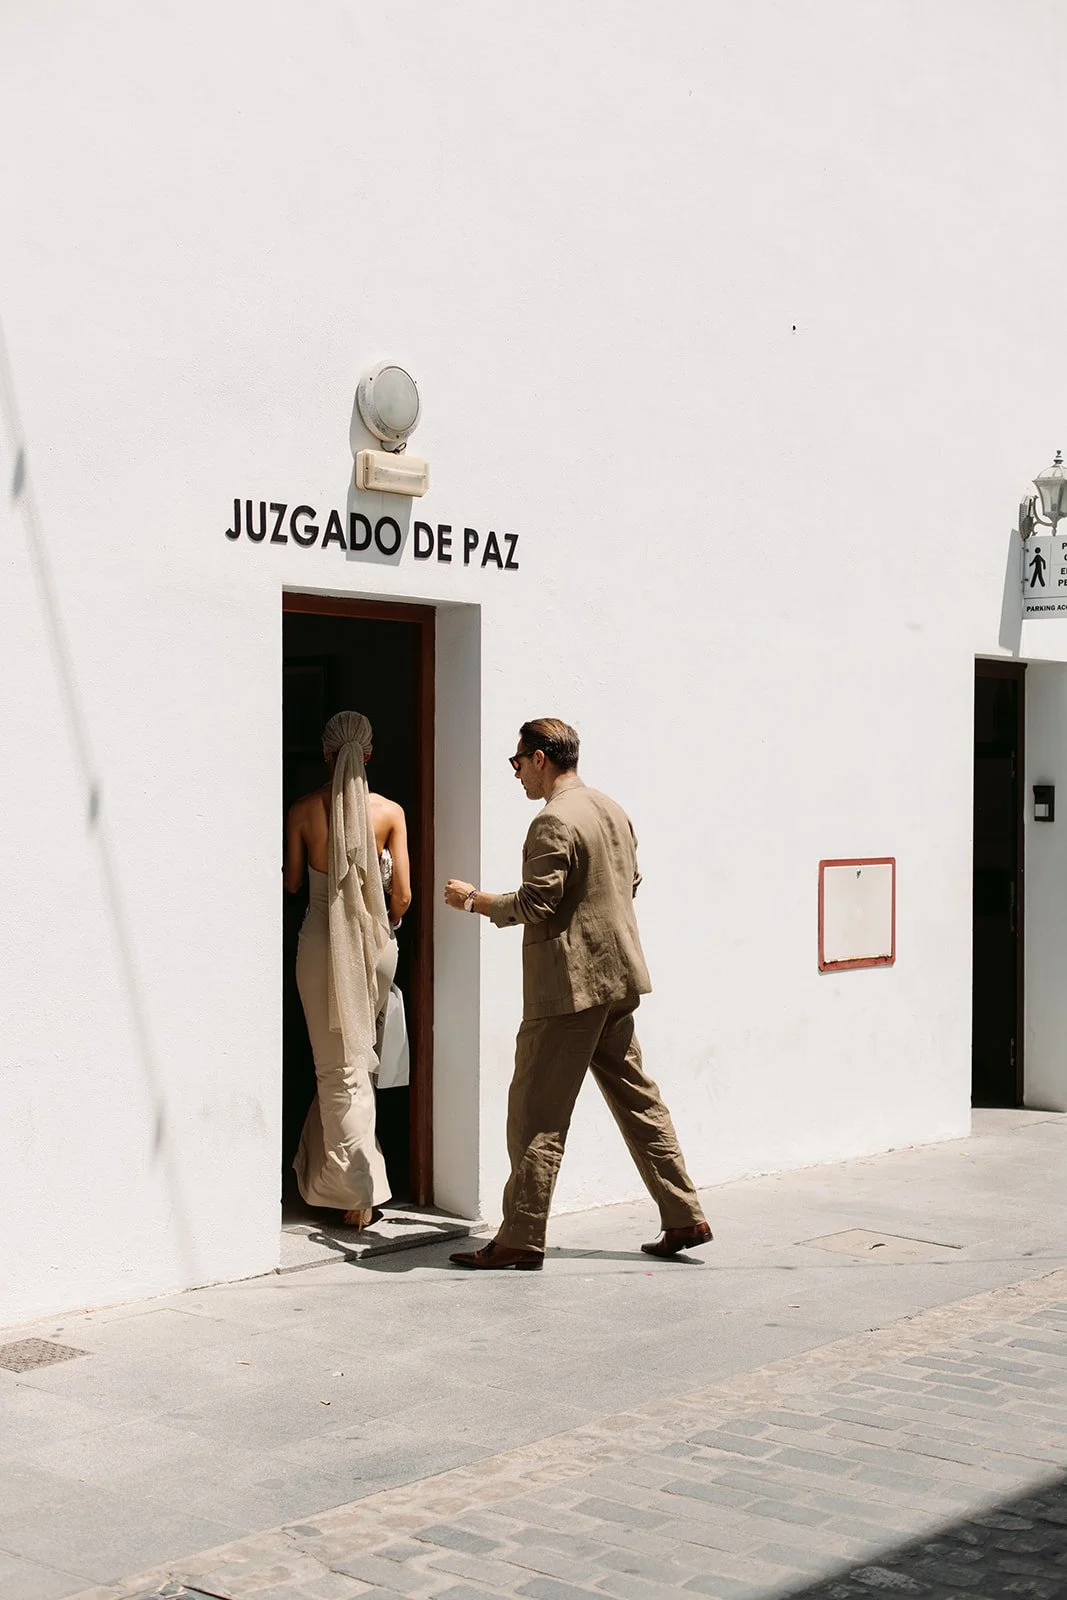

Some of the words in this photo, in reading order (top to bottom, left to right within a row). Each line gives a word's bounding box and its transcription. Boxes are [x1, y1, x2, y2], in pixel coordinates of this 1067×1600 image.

[225, 498, 401, 556] JUZGADO
[413, 521, 453, 563] DE
[463, 527, 520, 570] PAZ
